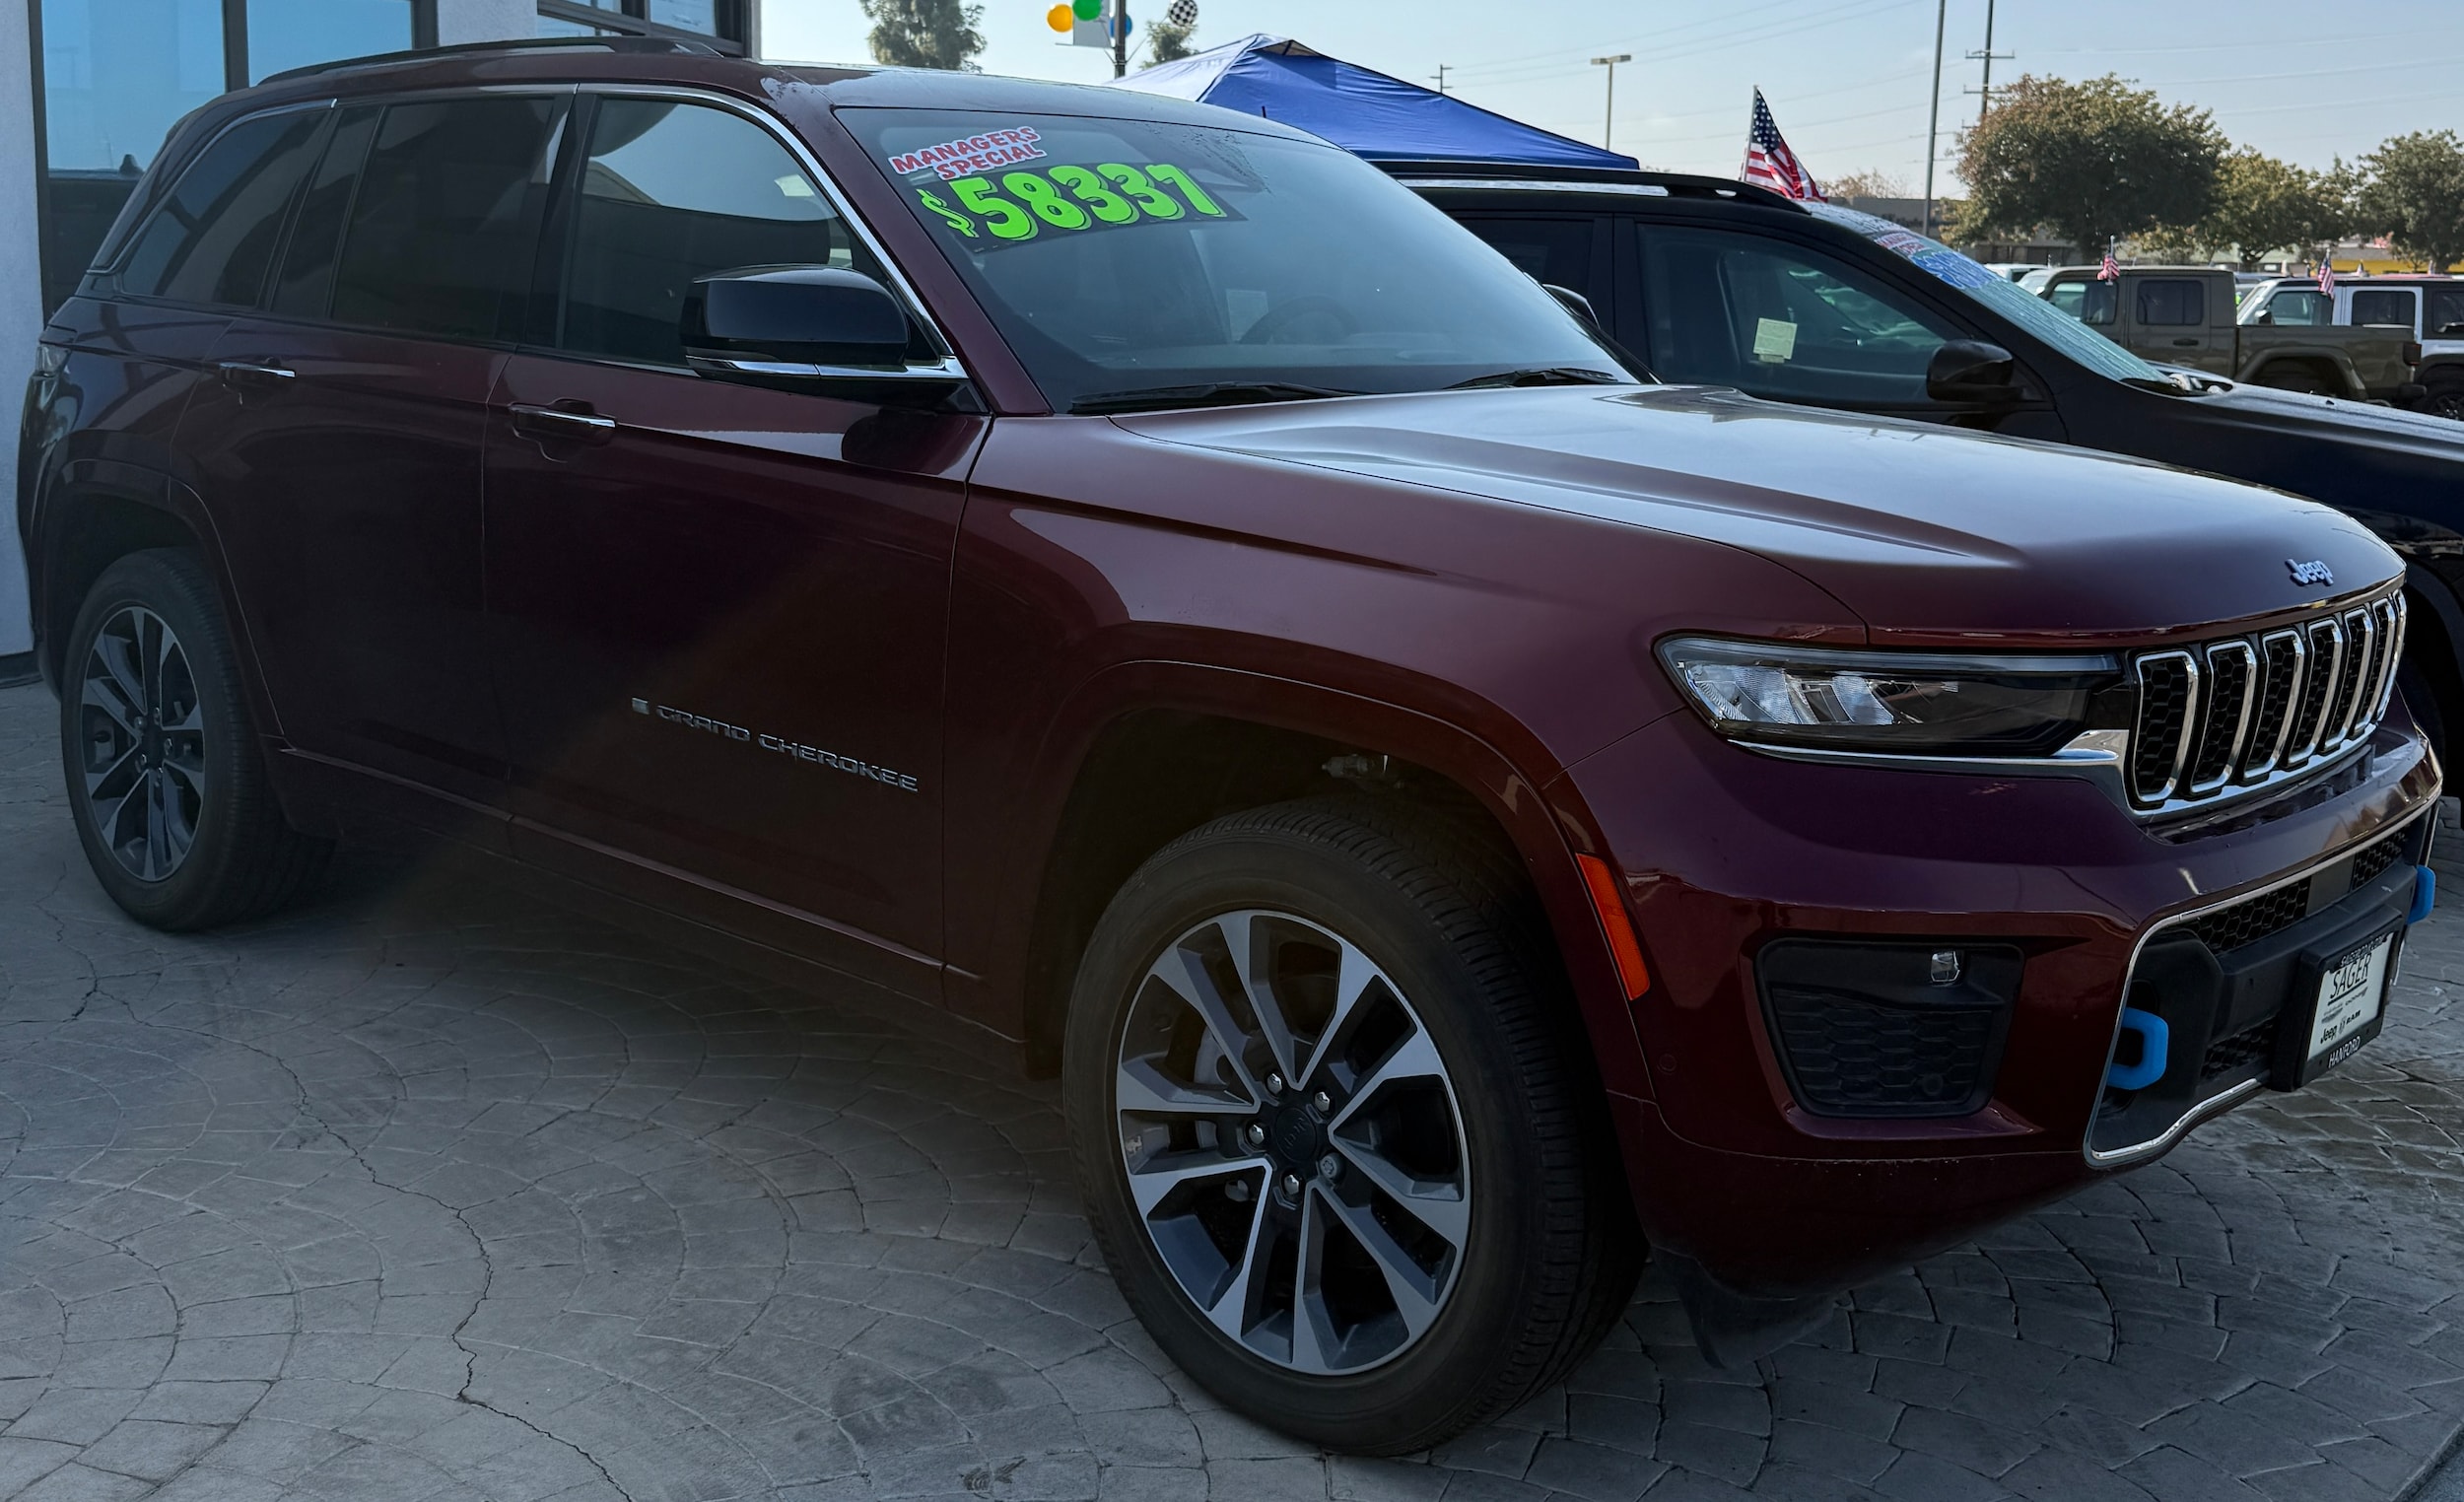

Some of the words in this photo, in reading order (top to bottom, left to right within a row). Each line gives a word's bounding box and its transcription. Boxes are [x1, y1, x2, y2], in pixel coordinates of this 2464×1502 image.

[892, 127, 1041, 173] MANAGERS
[937, 144, 1044, 179] SPECIAL
[2285, 559, 2334, 585] Jeep
[656, 705, 750, 741] GRAND
[758, 733, 919, 792] CHEROKEE
[2329, 953, 2371, 999] SAGER
[2320, 1025, 2337, 1044] Jeep
[2328, 1036, 2361, 1068] HANFORD
